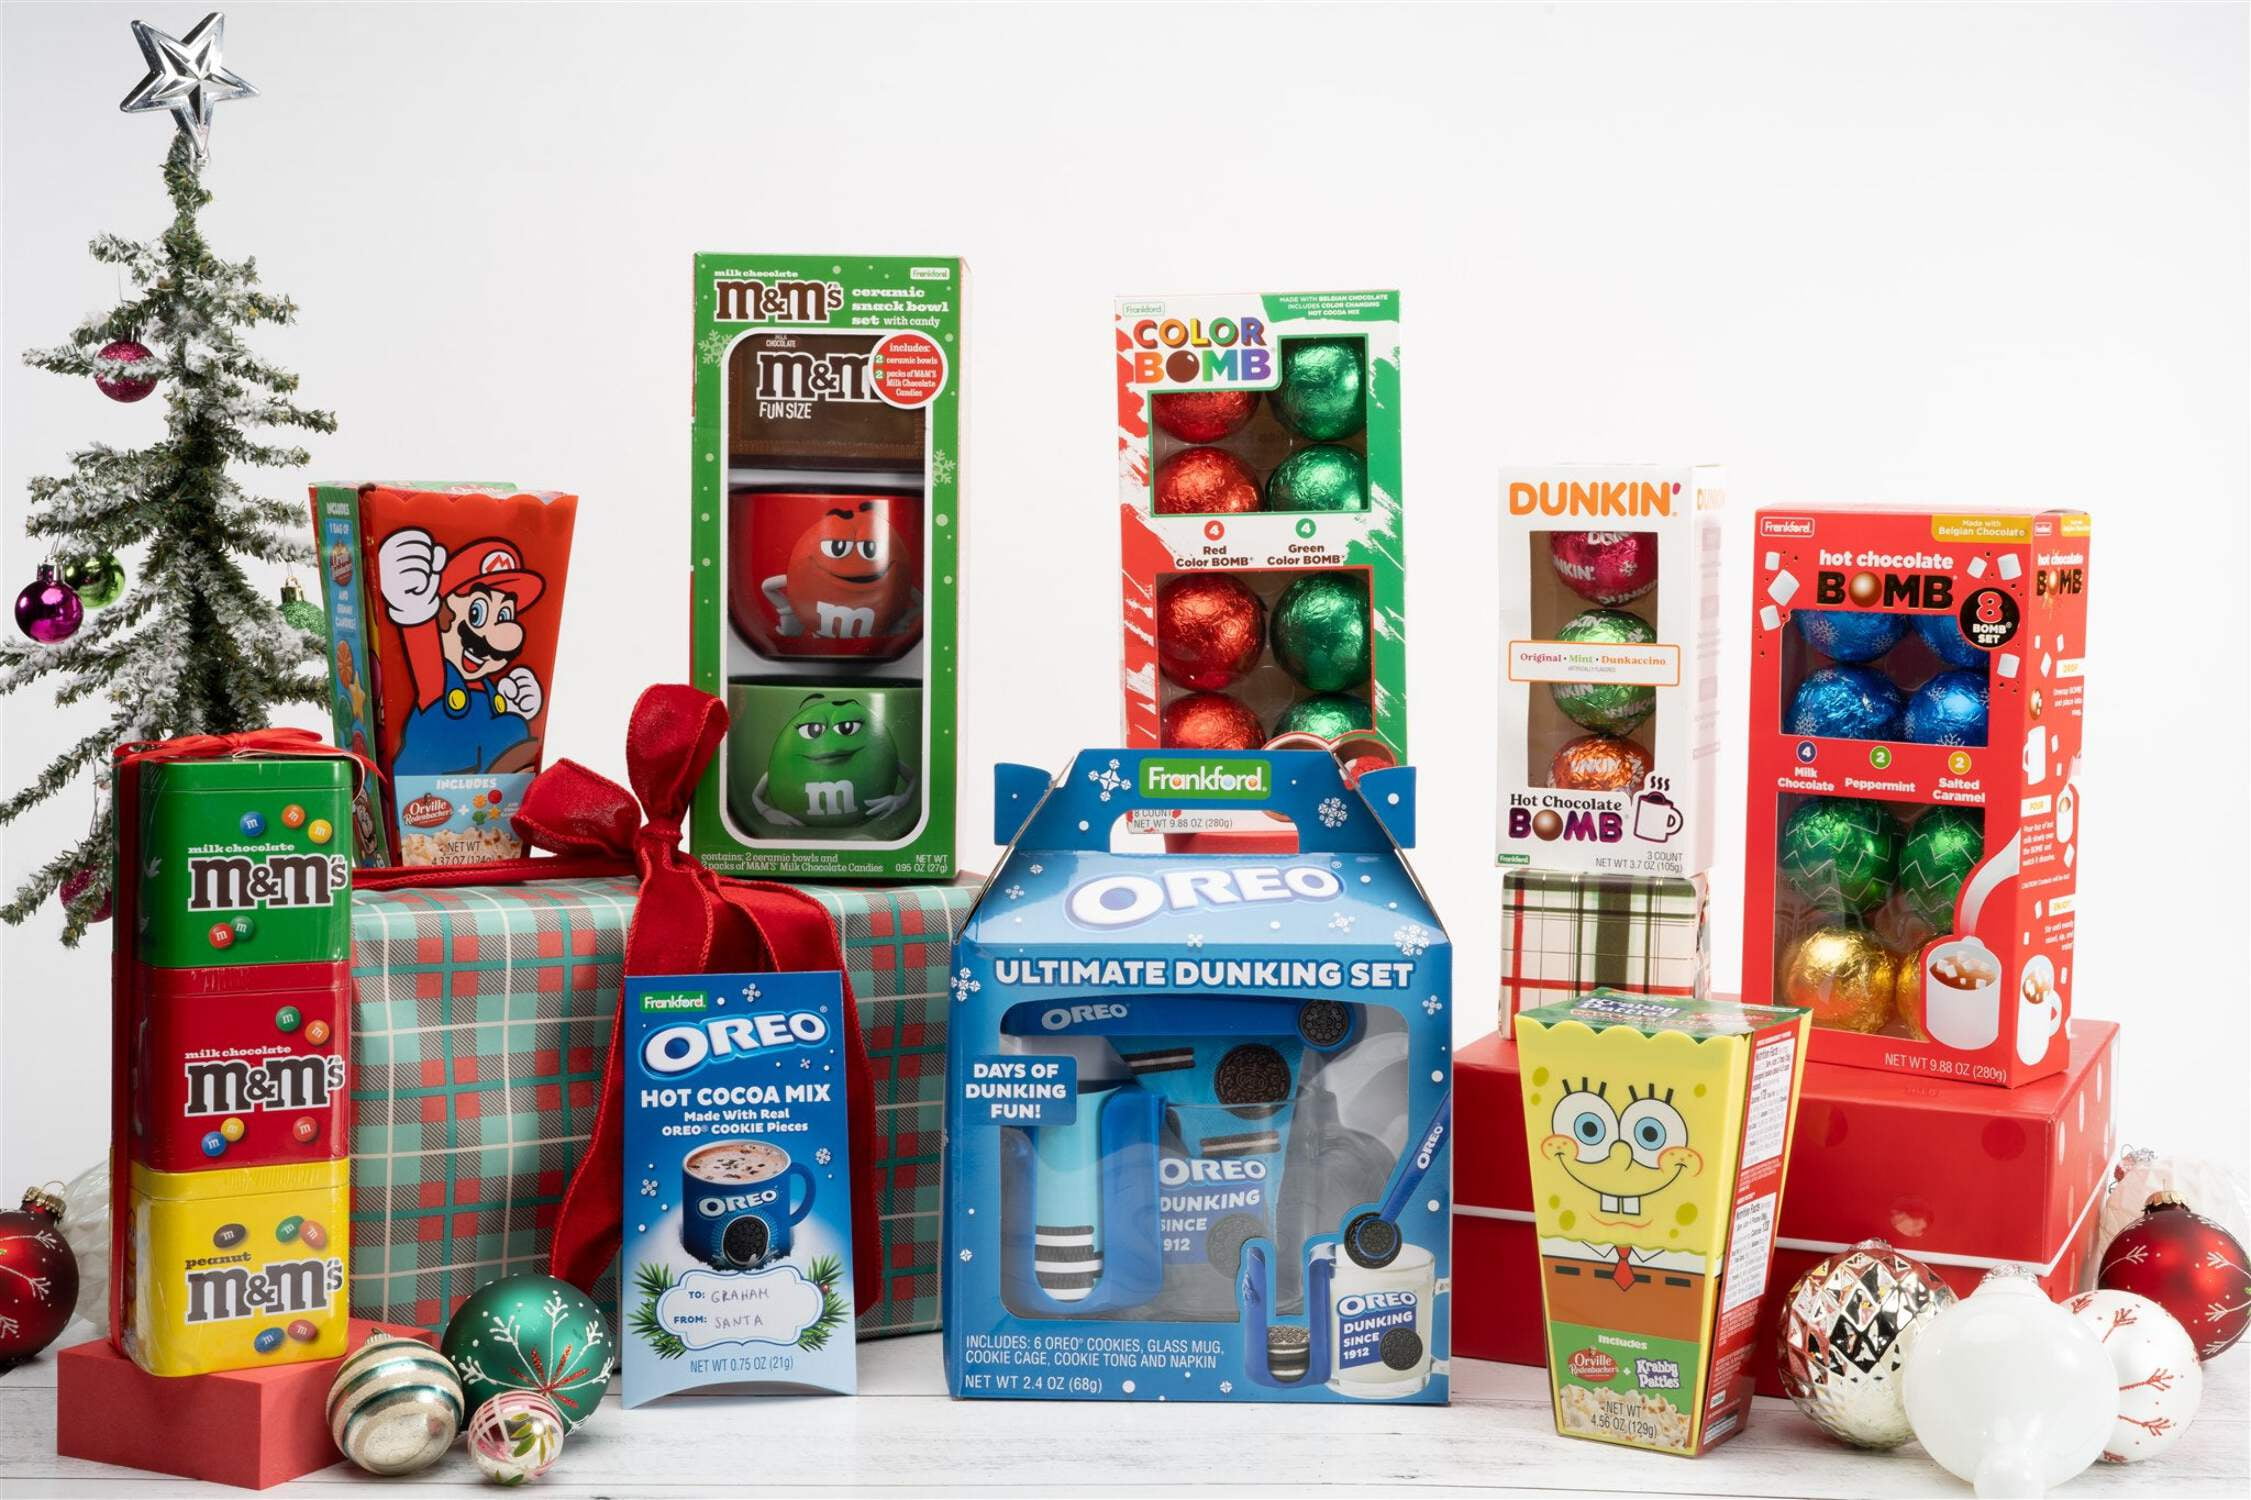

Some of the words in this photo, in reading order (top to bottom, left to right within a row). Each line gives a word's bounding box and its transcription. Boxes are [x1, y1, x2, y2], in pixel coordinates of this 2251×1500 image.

[714, 269, 742, 278] milk
[743, 269, 798, 278] chocolate
[852, 286, 925, 298] ceramic
[1348, 294, 1388, 302] CHOCOLATE
[852, 301, 904, 312] snack
[906, 301, 949, 312] bowl
[1321, 302, 1345, 310] COLOR
[1346, 301, 1380, 309] CHANGING
[852, 316, 879, 326] set
[883, 316, 907, 326] with
[909, 316, 940, 328] candy
[1133, 316, 1268, 349] COLOR
[766, 339, 796, 348] CHOCOLATE
[1134, 349, 1272, 384] BOMB
[759, 402, 784, 419] FUN
[786, 402, 812, 419] SIZE
[1509, 481, 1681, 517] DUNKIN'
[1764, 520, 1812, 535] Frankford
[1961, 519, 1983, 528] Made
[1985, 520, 2002, 528] with
[1938, 526, 1974, 538] Belgian
[1976, 527, 2025, 538] Chocolate
[1203, 545, 1227, 556] Red
[1288, 543, 1325, 554] Green
[1176, 558, 1209, 568] Color
[1267, 555, 1300, 566] Color
[1819, 549, 1853, 568] hot
[1856, 551, 1954, 570] chocolate
[1816, 570, 1955, 610] BOMB
[2036, 569, 2082, 596] BOMB
[1975, 590, 2003, 624] 8
[1972, 622, 2007, 635] BOMB
[1977, 633, 2000, 645] SET
[1520, 653, 1562, 664] Original
[1568, 653, 1593, 664] Mint
[1601, 655, 1666, 666] Dunkaccino
[1148, 766, 1264, 792] Frankford
[1795, 766, 1818, 779] Milk
[436, 777, 497, 790] INCLUDES
[1777, 777, 1835, 792] Chocolate
[1845, 777, 1916, 793] Peppermint
[1939, 777, 1980, 791] Salted
[1510, 794, 1538, 807] Hot
[1542, 795, 1622, 812] Chocolate
[1932, 788, 1986, 803] Caramel
[409, 799, 447, 816] Orville
[1134, 819, 1151, 829] NET
[1152, 819, 1168, 829] WT
[1205, 818, 1233, 829] (280g)
[1508, 807, 1624, 844] BOMB
[188, 844, 224, 855] milk
[225, 843, 295, 854] chocolate
[447, 841, 466, 853] NET
[466, 841, 480, 853] WT
[752, 854, 791, 862] ceramic
[792, 853, 819, 862] bowls
[916, 854, 931, 862] NET
[933, 854, 948, 862] WT
[1654, 851, 1683, 862] COUNT
[779, 863, 800, 872] Milk
[801, 863, 848, 872] Chocolate
[848, 863, 884, 872] Candies
[1595, 857, 1612, 867] NET
[1613, 858, 1628, 868] WT
[1629, 858, 1642, 869] 3.7
[1656, 860, 1683, 873] (105g)
[1072, 866, 1341, 927] OREO
[995, 960, 1166, 986] ULTIMATE
[1175, 960, 1342, 987] DUNKING
[1350, 962, 1415, 987] SET
[644, 994, 704, 1009] Frankford
[1041, 1003, 1129, 1031] OREO
[645, 1012, 827, 1073] OREO
[184, 1049, 221, 1060] milk
[222, 1045, 292, 1058] chocolate
[973, 1063, 1026, 1078] DAYS
[1030, 1063, 1059, 1078] OF
[1884, 1052, 1907, 1067] NET
[1909, 1056, 1929, 1071] WT
[1929, 1058, 1953, 1073] 9.88
[1955, 1062, 1970, 1077] OZ
[1972, 1064, 2007, 1084] (280g)
[641, 1088, 692, 1108] HOT
[697, 1085, 780, 1107] COCOA
[786, 1083, 832, 1104] MIX
[965, 1082, 1066, 1099] DUNKING
[684, 1110, 720, 1122] Made
[723, 1109, 757, 1121] With
[761, 1108, 790, 1119] Real
[990, 1103, 1042, 1119] FUN!
[711, 1122, 764, 1134] COOKIE
[767, 1121, 809, 1133] Pieces
[1417, 1125, 1444, 1169] OREO
[1159, 1158, 1267, 1186] OREO
[698, 1189, 778, 1217] OREO
[1160, 1189, 1261, 1212] DUNKING
[185, 1251, 252, 1270] peanut
[688, 1291, 705, 1300] TO:
[711, 1287, 770, 1304] GRAHAM
[1338, 1291, 1417, 1316] OREO
[674, 1315, 707, 1325] FROM:
[714, 1315, 764, 1330] SANTA
[1344, 1311, 1413, 1334] DUNKING
[966, 1335, 1030, 1350] INCLUDES:
[1033, 1337, 1042, 1349] 6
[1086, 1338, 1144, 1354] COOKIES,
[1147, 1339, 1188, 1353] GLASS
[1191, 1340, 1225, 1355] MUG,
[1344, 1332, 1380, 1347] SINCE
[1598, 1334, 1648, 1350] includes
[966, 1351, 1011, 1365] COOKIE
[1014, 1351, 1050, 1367] CAGE,
[1054, 1352, 1099, 1366] COOKIE
[1103, 1353, 1137, 1367] TONG
[1140, 1354, 1167, 1367] AND
[1170, 1354, 1217, 1369] NAPKIN
[1344, 1347, 1370, 1360] 1912
[1574, 1352, 1612, 1367] Orville
[690, 1360, 710, 1374] NET
[711, 1359, 729, 1372] WT
[730, 1358, 751, 1372] 0.75
[753, 1356, 767, 1370] OZ
[769, 1356, 794, 1371] (21g)
[1635, 1358, 1679, 1377] Krabby
[965, 1375, 991, 1390] NET
[996, 1375, 1018, 1390] WT
[1023, 1375, 1042, 1390] 2.4
[1047, 1377, 1065, 1391] OZ
[1068, 1376, 1103, 1394] (68g)
[1638, 1374, 1681, 1389] Patties
[1606, 1401, 1625, 1415] NET
[1626, 1403, 1642, 1416] WT
[1590, 1414, 1611, 1430] 4.56
[1612, 1418, 1626, 1431] OZ
[1628, 1419, 1657, 1439] (129g)
